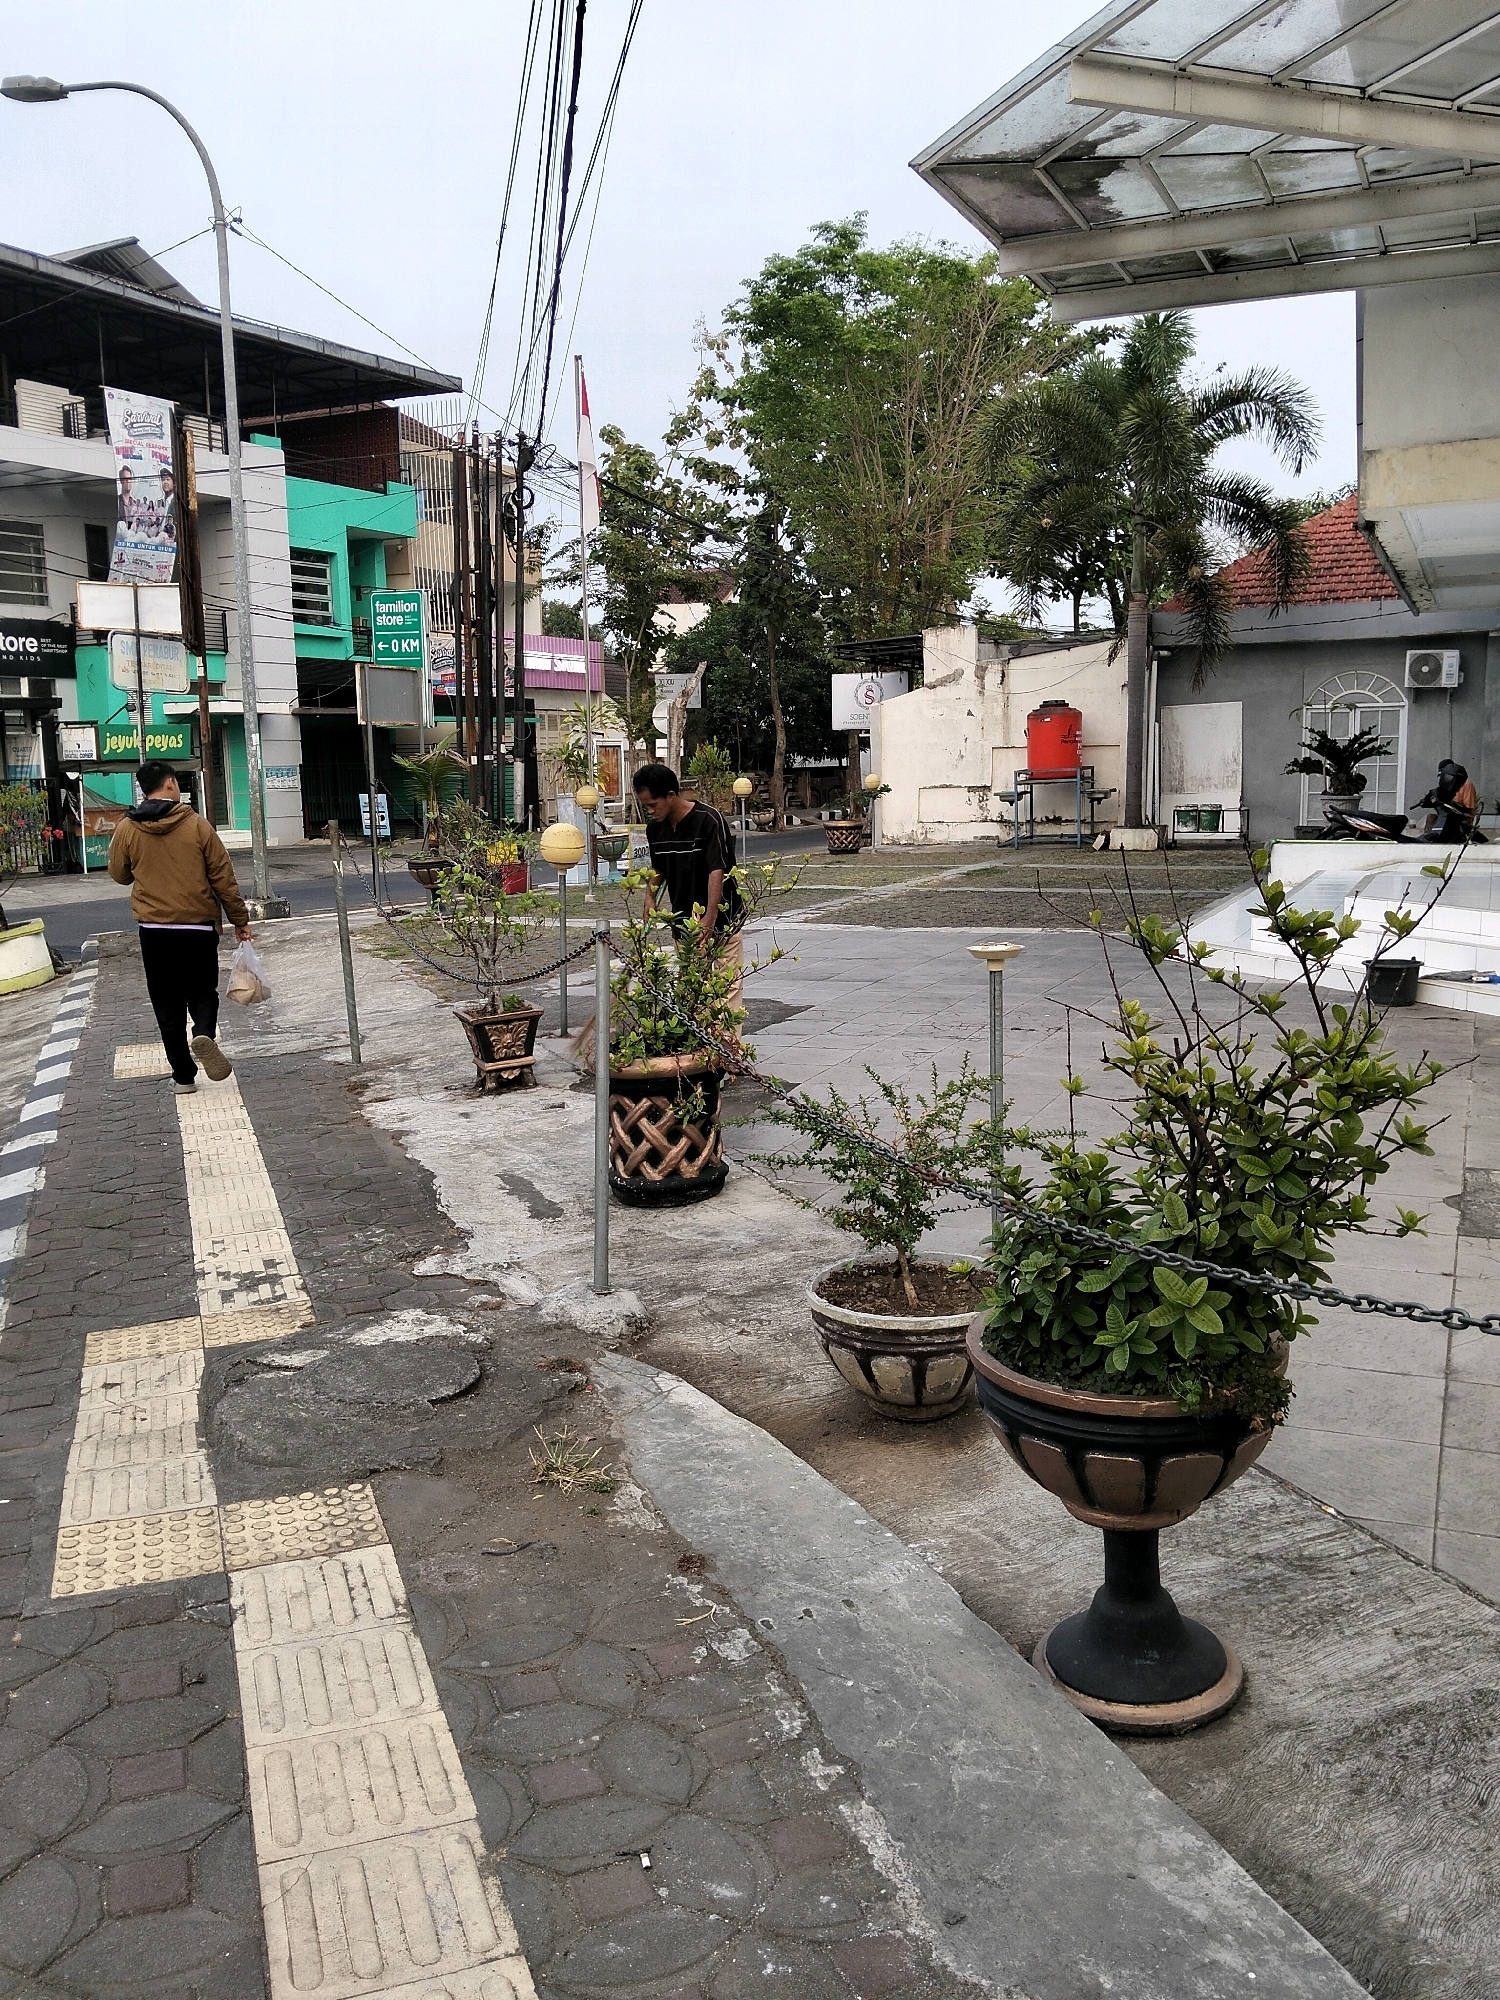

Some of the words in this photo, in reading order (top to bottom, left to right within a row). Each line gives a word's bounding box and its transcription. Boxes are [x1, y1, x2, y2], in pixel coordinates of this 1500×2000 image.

[137, 543, 156, 551] UNTUK
[375, 600, 418, 613] familion
[376, 614, 404, 626] store
[143, 643, 180, 660] PENABUR
[391, 639, 399, 653] 0
[401, 639, 420, 653] KM
[146, 734, 183, 752] peyas
